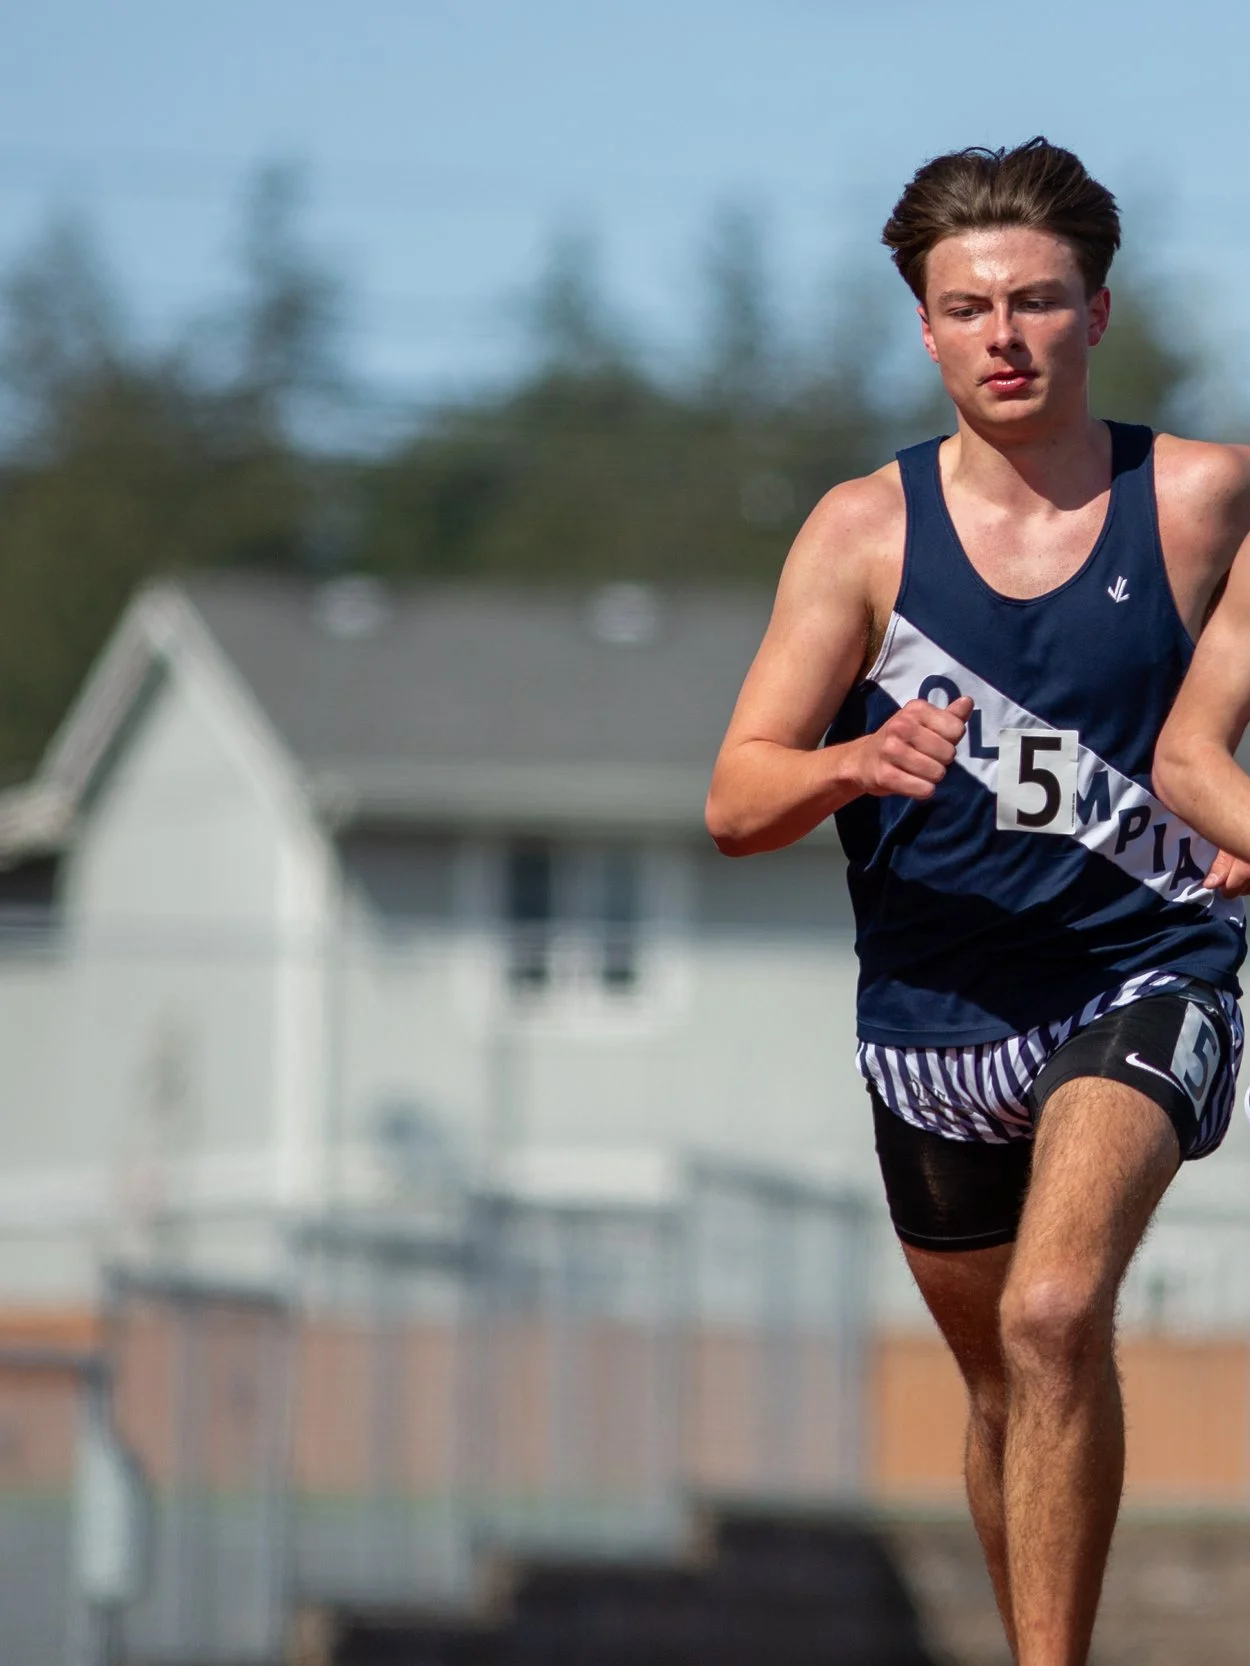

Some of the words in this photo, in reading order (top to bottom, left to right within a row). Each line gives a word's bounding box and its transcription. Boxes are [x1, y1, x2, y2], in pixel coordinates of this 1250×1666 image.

[917, 674, 1206, 891] OLMPIA
[1016, 736, 1061, 828] 5
[1183, 1020, 1218, 1102] 5
